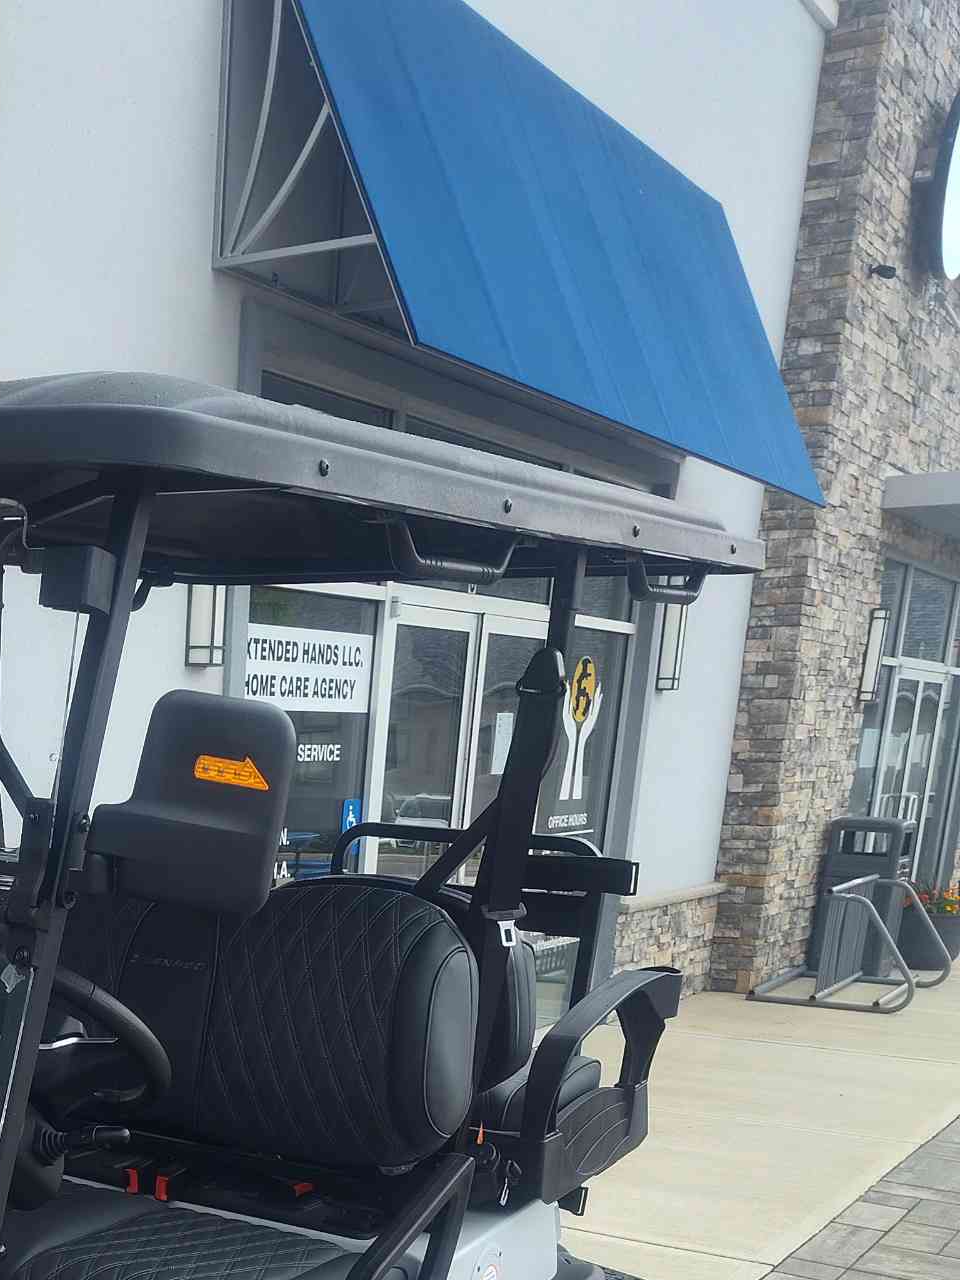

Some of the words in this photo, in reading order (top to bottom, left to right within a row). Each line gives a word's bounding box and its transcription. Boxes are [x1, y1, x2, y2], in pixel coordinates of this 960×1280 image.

[247, 638, 299, 662] XTENDED
[302, 642, 339, 665] HANDS
[280, 675, 310, 698] CARE
[312, 677, 356, 700] AGENCY
[297, 743, 341, 761] SERVICE
